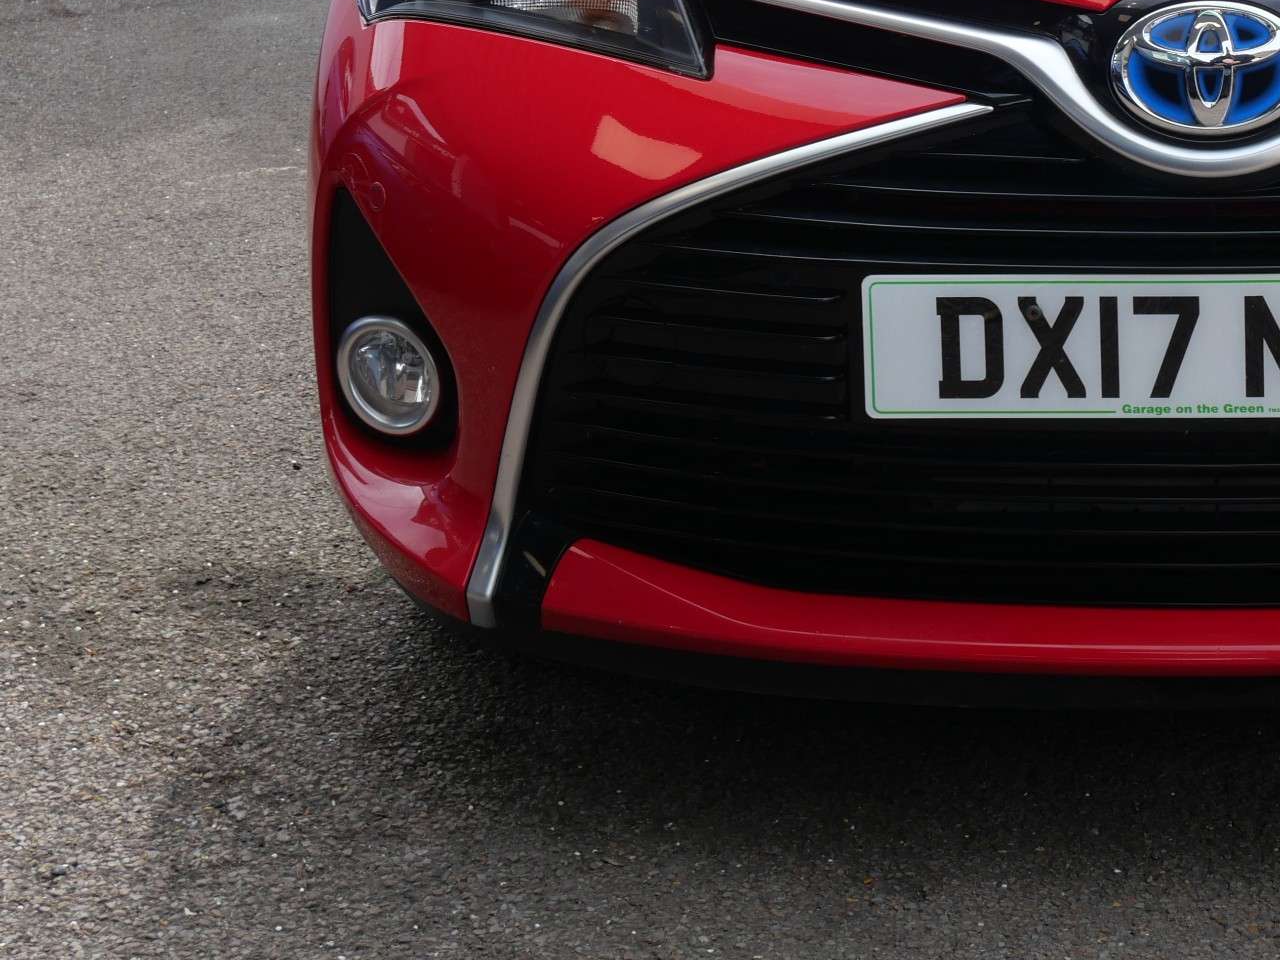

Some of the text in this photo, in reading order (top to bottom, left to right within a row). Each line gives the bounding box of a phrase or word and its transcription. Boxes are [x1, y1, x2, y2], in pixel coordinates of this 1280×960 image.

[936, 296, 1200, 399] DX17
[1121, 403, 1172, 416] Garage
[1175, 405, 1193, 414] on
[1196, 403, 1219, 414] the
[1222, 403, 1265, 414] Green
